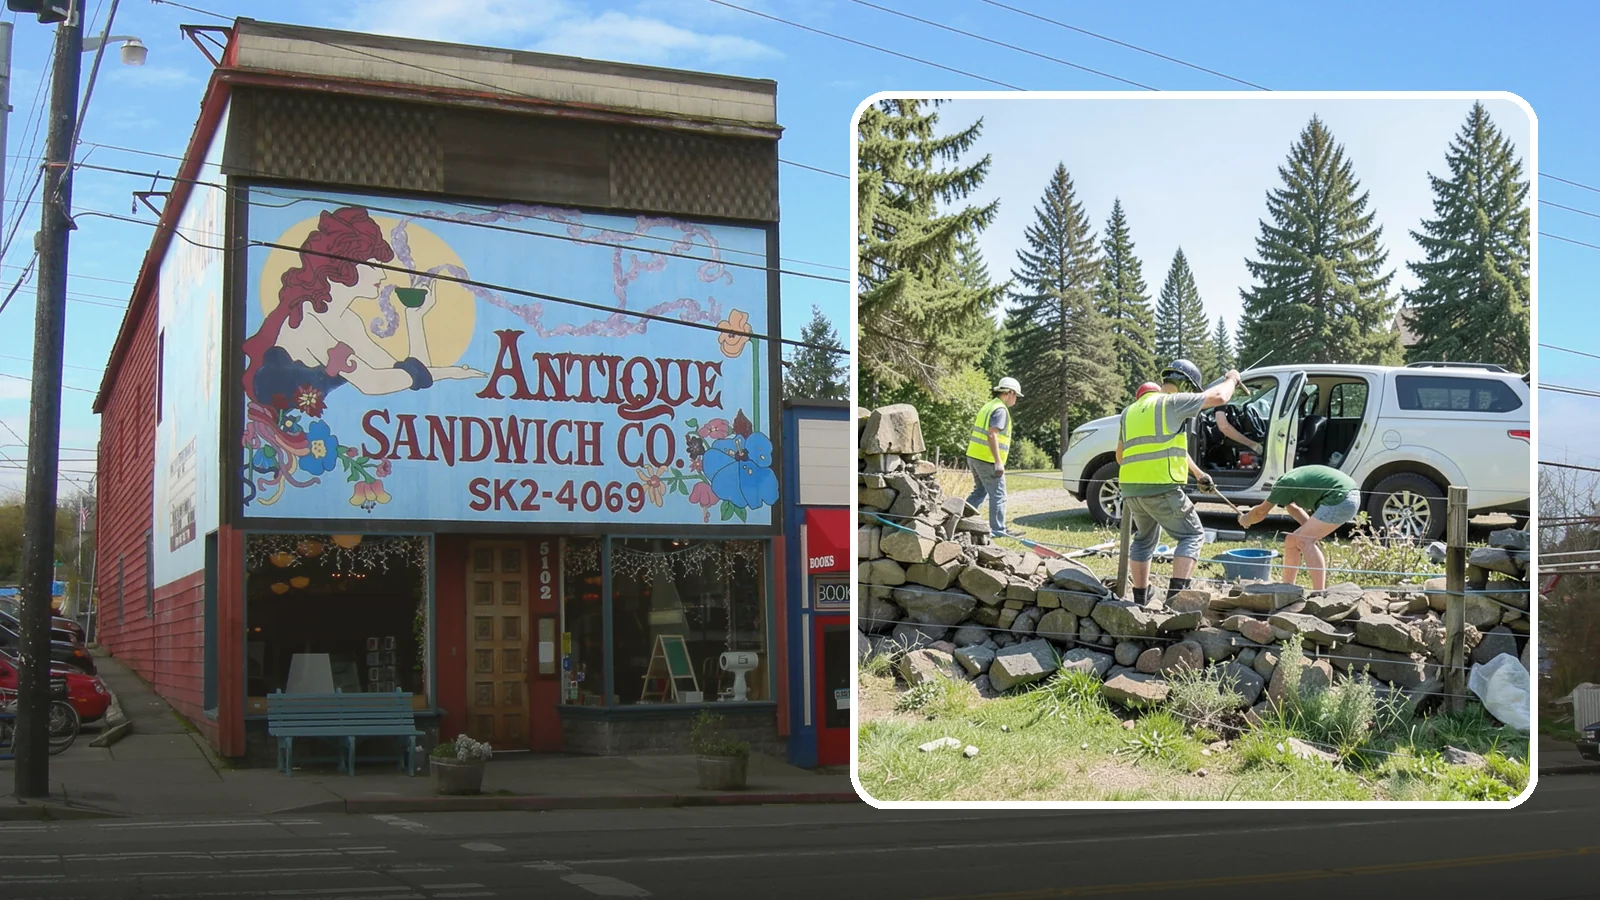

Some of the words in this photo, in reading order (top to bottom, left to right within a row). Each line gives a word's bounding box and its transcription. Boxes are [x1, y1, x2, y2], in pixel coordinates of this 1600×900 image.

[476, 330, 723, 420] ANTIQUE
[362, 409, 605, 466] SANDWICH
[617, 420, 686, 468] CO.
[469, 477, 645, 512] SK2-4069
[540, 541, 551, 600] 5102
[809, 555, 835, 569] BOOKS
